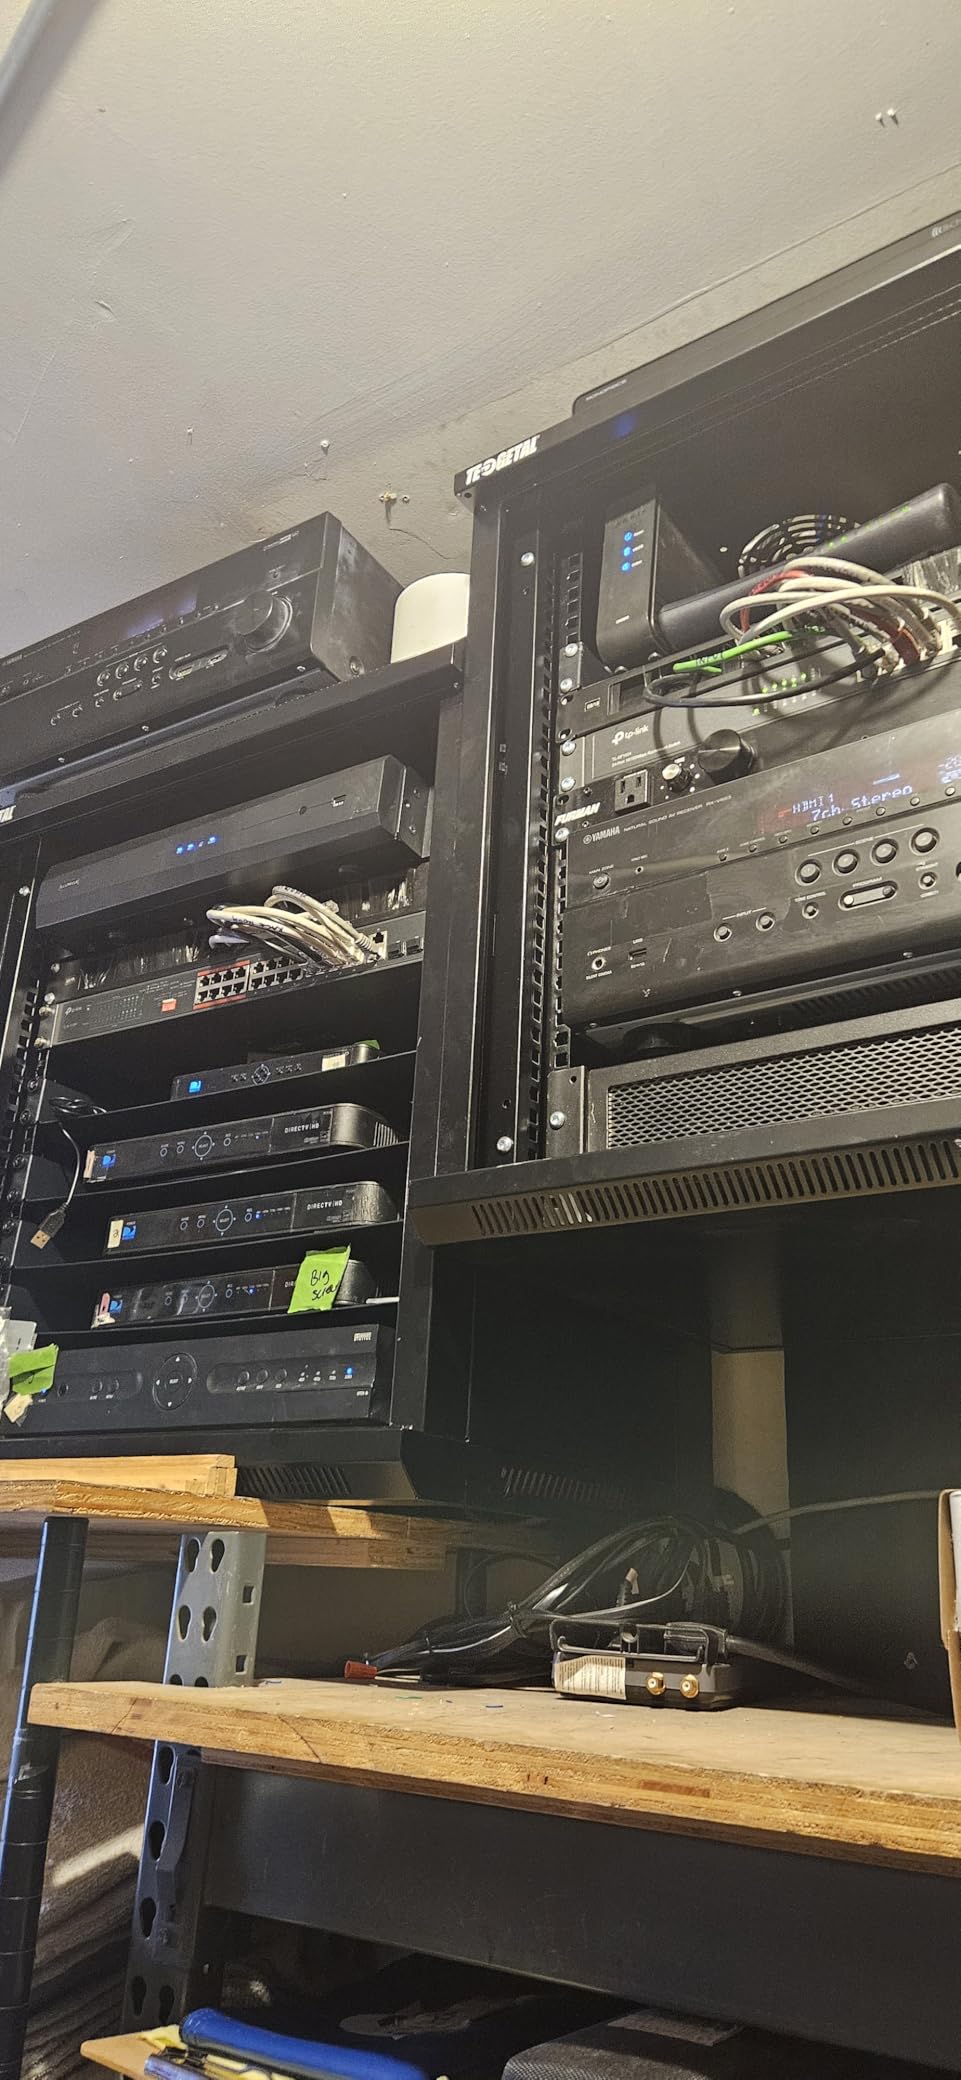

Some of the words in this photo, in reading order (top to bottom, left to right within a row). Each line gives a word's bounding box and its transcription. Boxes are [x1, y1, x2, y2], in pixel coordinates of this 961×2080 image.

[554, 802, 601, 827] FURMAN
[812, 807, 842, 821] 7ch
[851, 785, 914, 809] Stereo
[591, 825, 621, 843] YAMAHA
[623, 822, 647, 832] NATURAL
[649, 815, 668, 825] SOUND
[676, 804, 703, 816] RECEIVER
